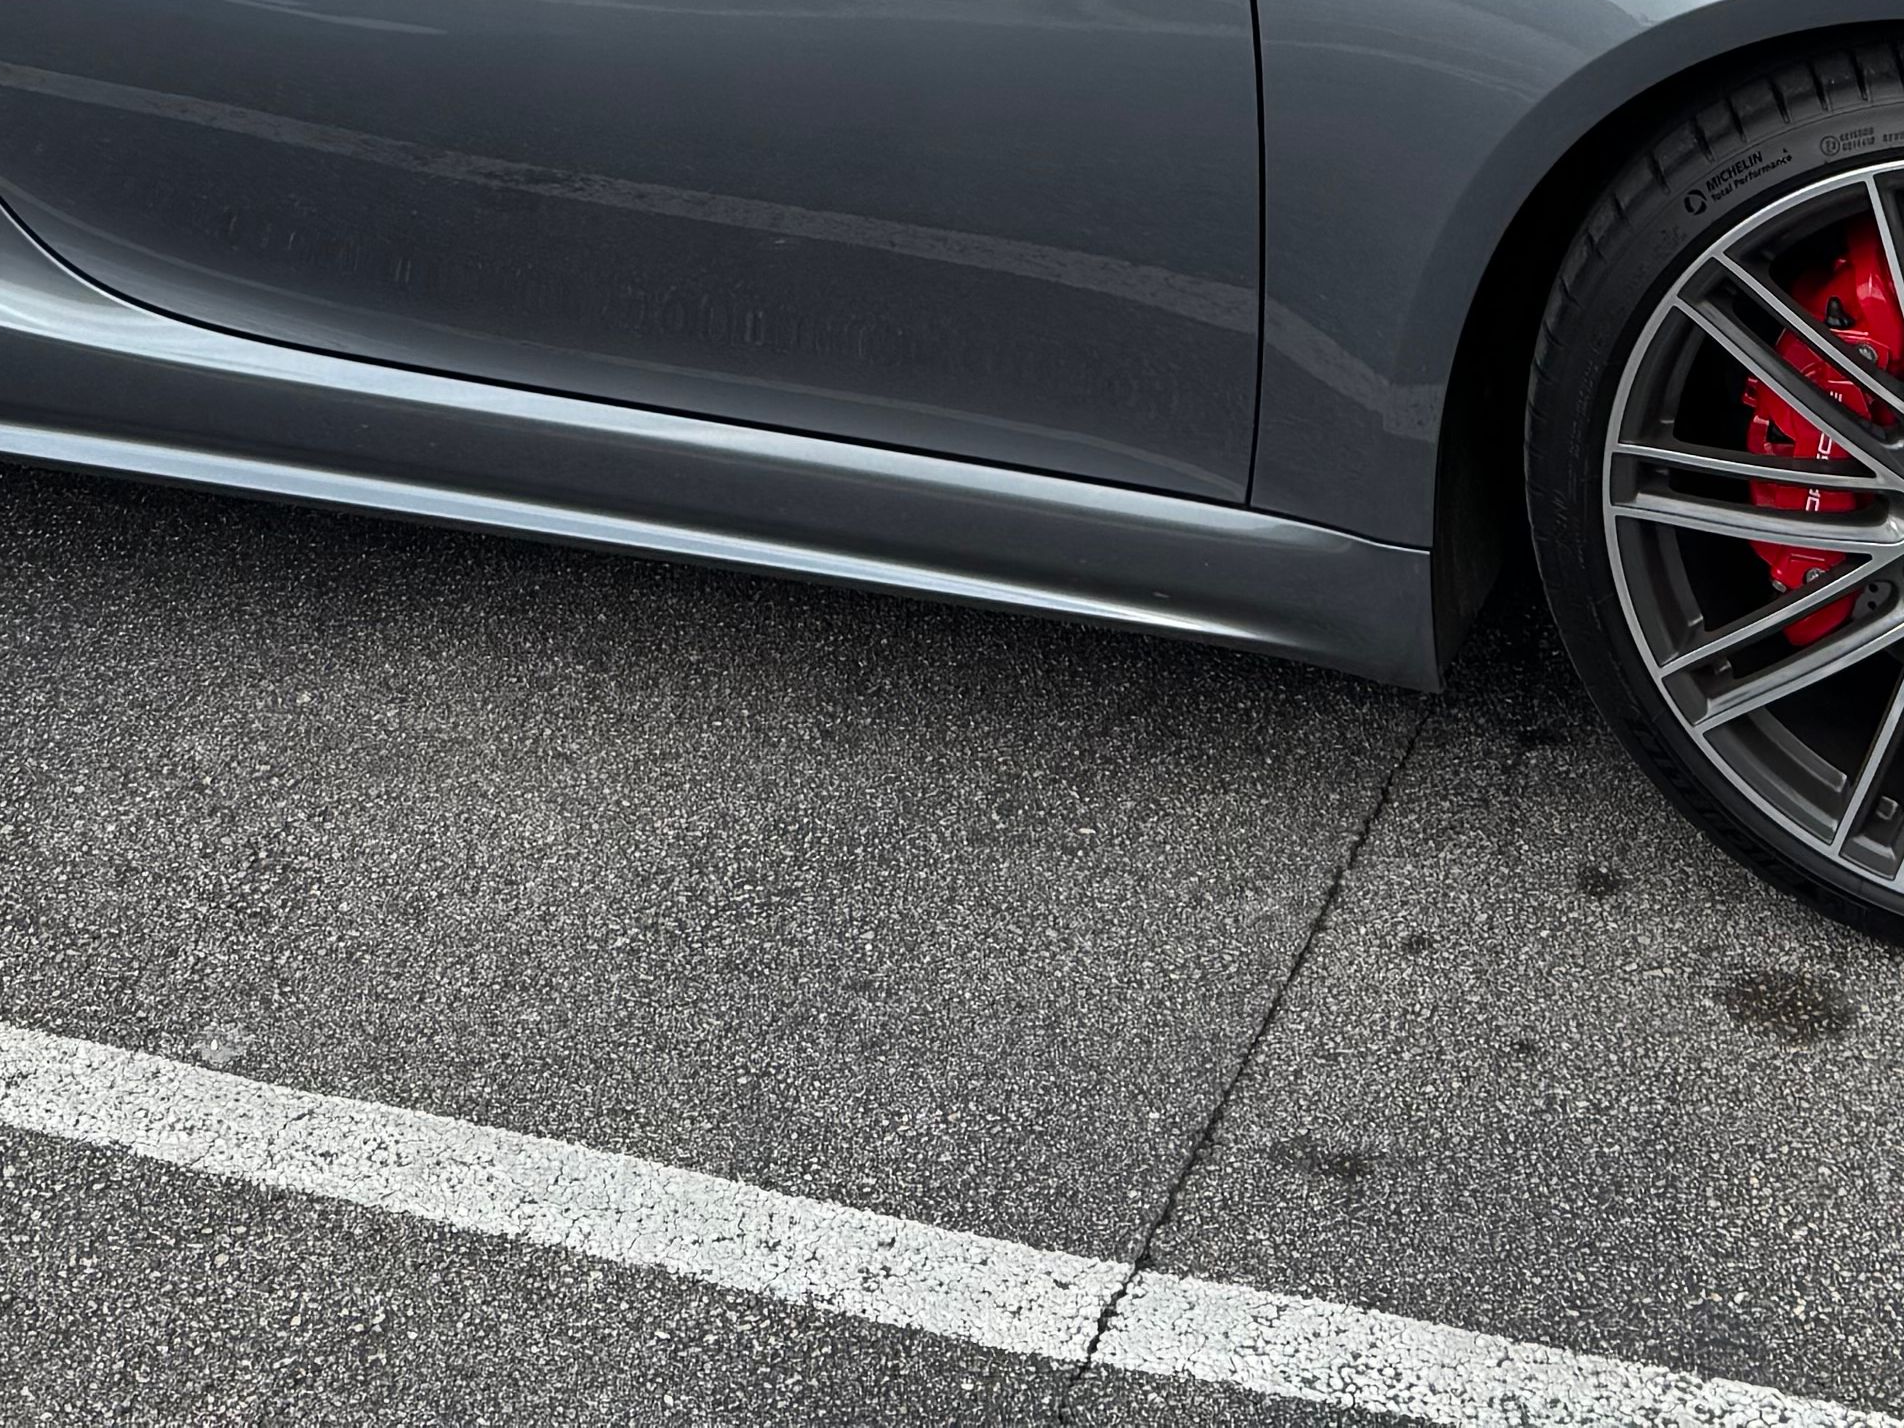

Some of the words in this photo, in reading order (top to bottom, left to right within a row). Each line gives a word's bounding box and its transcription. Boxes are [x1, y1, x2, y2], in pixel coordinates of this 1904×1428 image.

[1705, 150, 1763, 192] MICHELIN
[1711, 184, 1733, 202] Total
[1733, 154, 1793, 190] Performance
